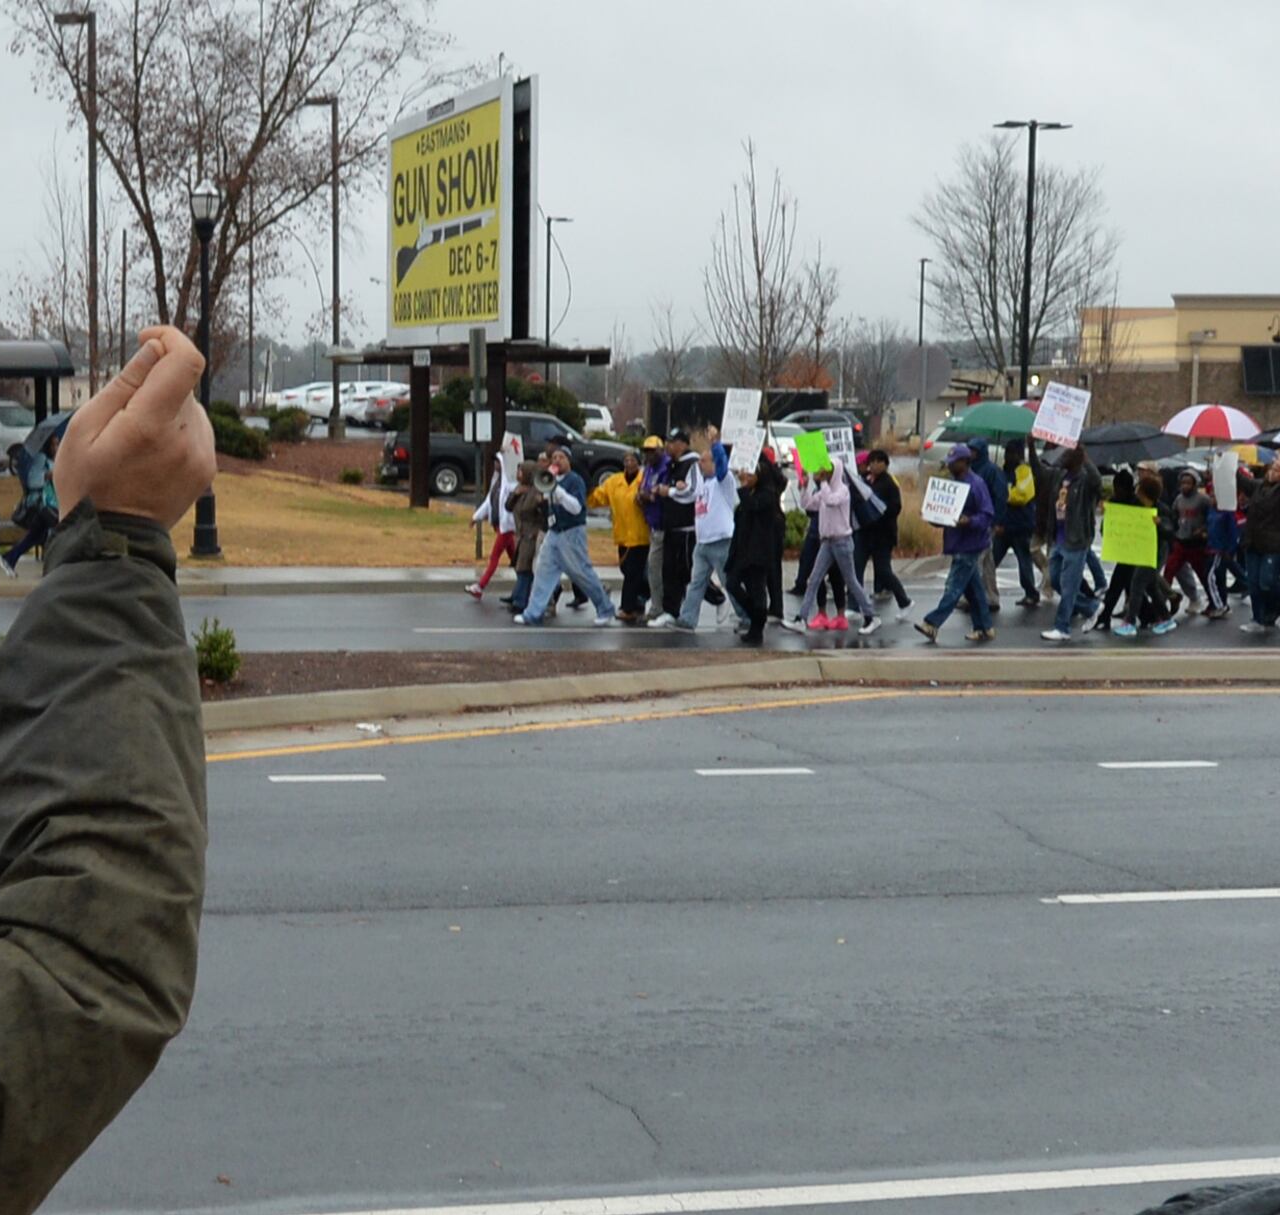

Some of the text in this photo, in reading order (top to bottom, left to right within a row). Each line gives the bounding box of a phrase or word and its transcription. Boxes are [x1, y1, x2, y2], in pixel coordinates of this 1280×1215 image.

[420, 119, 465, 156] EASTMANS
[394, 138, 499, 227] GUN SHOW
[449, 239, 498, 277] DEC 6-7
[394, 279, 499, 323] COBB COUNTY CIVIC CENTER
[931, 479, 959, 495] BLACK
[932, 492, 955, 506] LIVES
